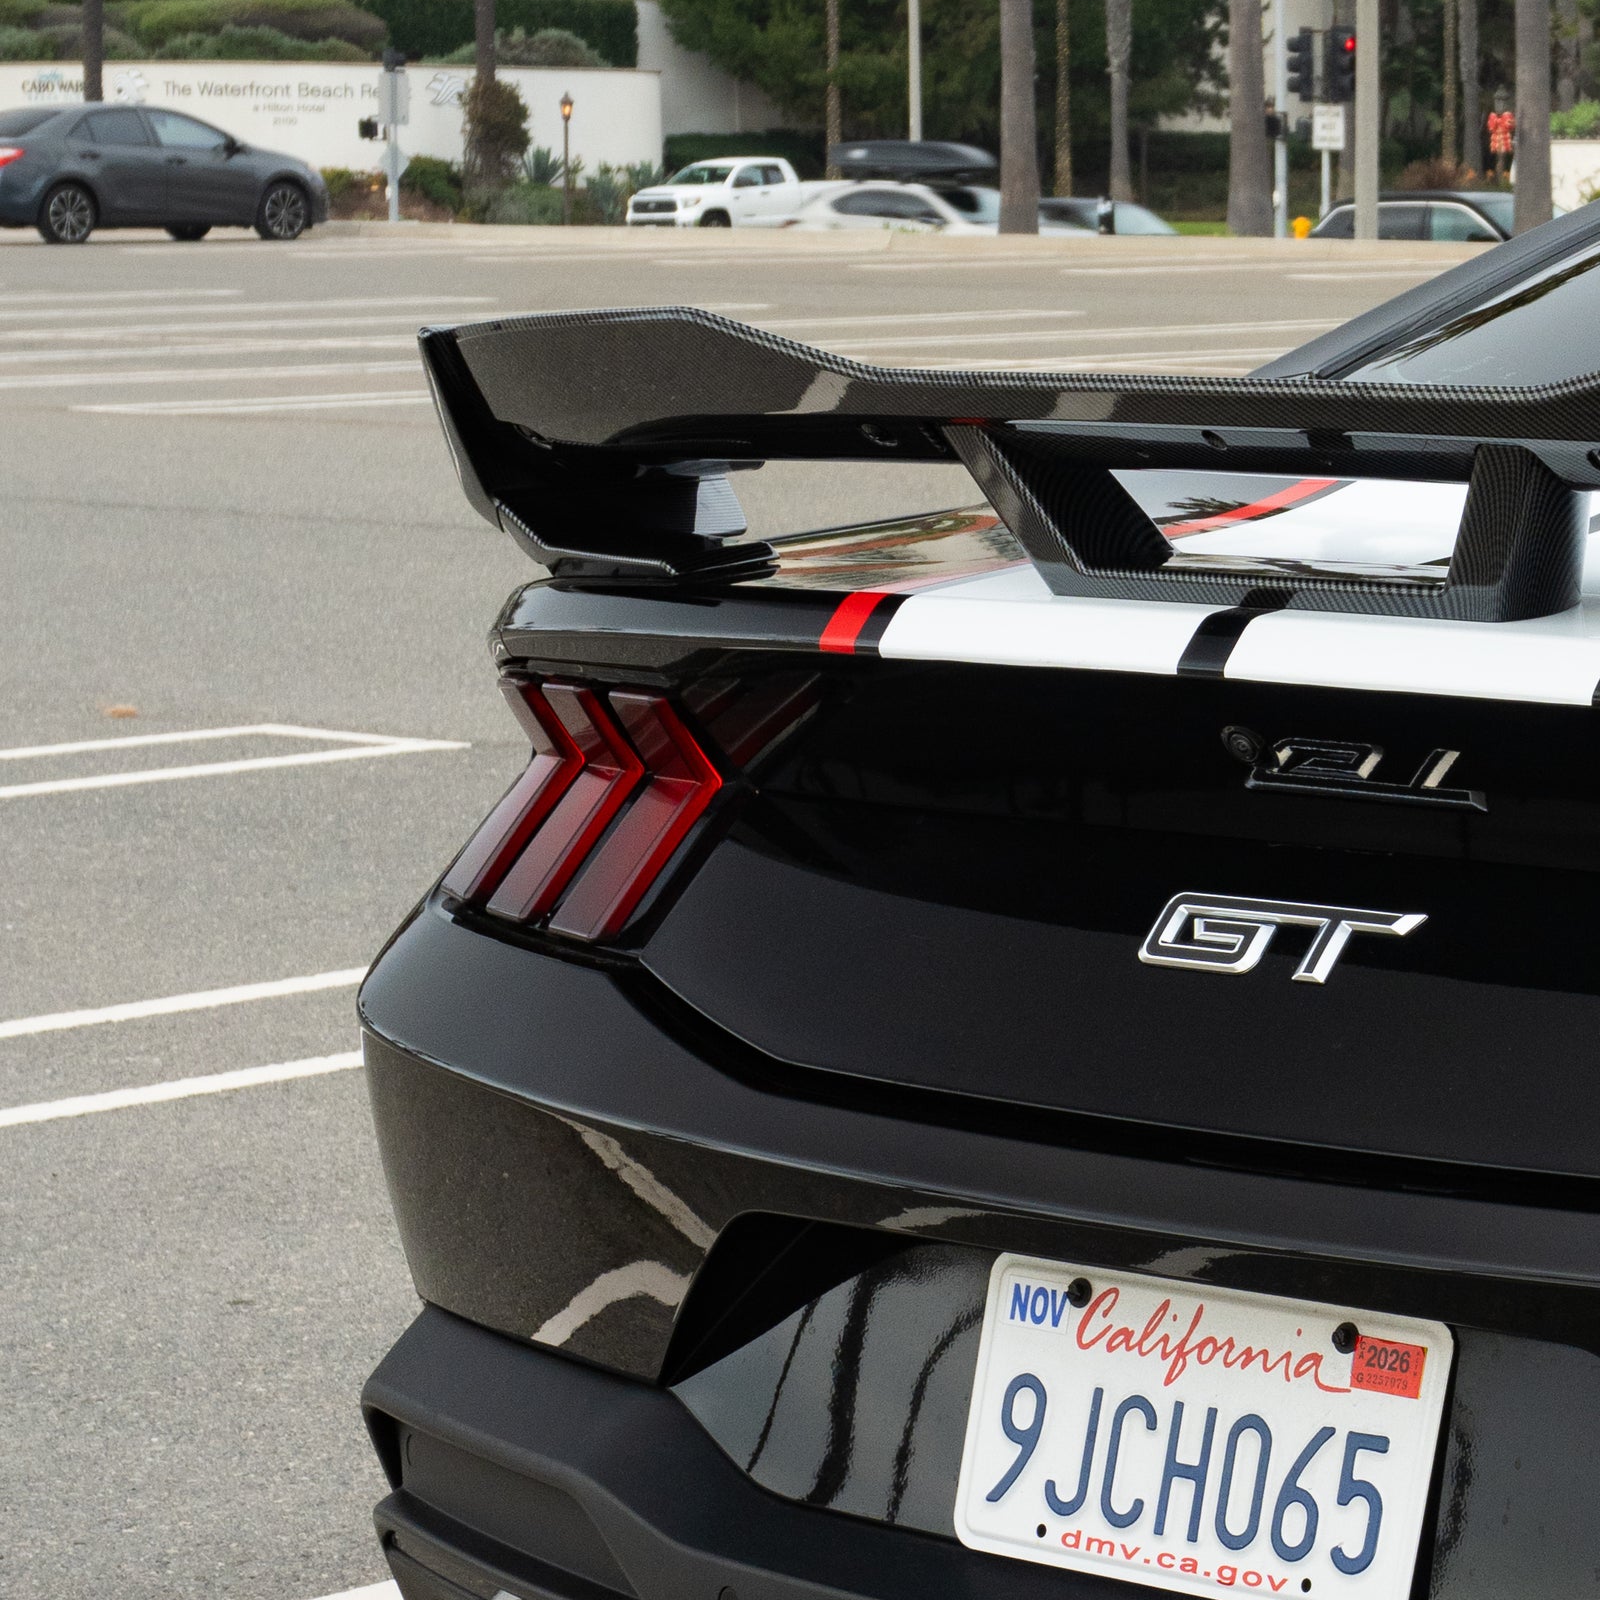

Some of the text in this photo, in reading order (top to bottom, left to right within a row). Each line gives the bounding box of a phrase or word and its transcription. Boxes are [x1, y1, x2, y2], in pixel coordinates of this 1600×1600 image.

[21, 79, 84, 93] CABO WAB
[164, 80, 192, 96] The
[196, 80, 291, 98] Waterfront
[298, 82, 354, 98] Beach
[263, 102, 294, 112] Hilton
[296, 102, 326, 112] Hotel
[1137, 891, 1429, 985] GT
[1009, 1282, 1068, 1329] NOV
[1076, 1286, 1352, 1394] California
[1365, 1344, 1412, 1374] 2026
[985, 1372, 1391, 1576] 9JCH065
[1060, 1527, 1289, 1594] dmv.ca.gov
